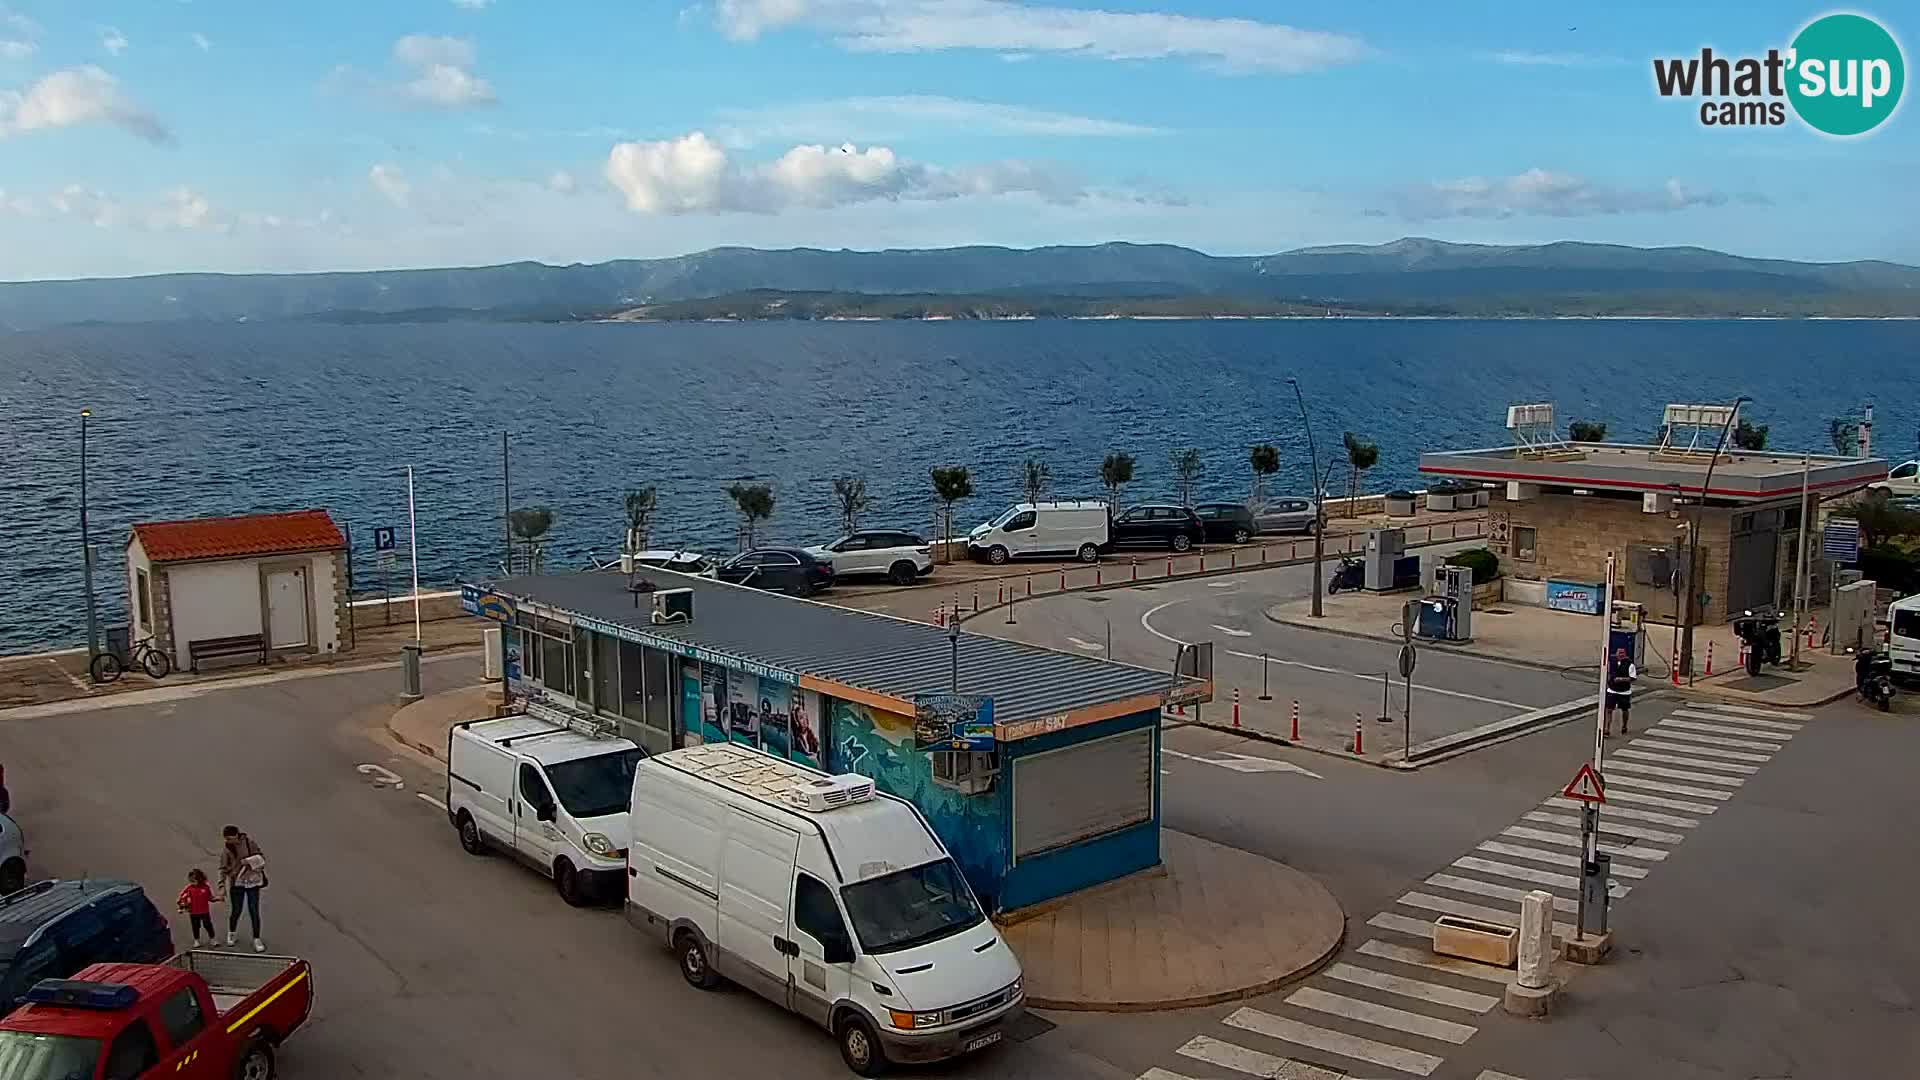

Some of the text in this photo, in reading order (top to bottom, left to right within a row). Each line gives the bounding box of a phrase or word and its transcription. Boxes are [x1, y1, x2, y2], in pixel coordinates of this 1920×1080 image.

[379, 530, 391, 548] P
[711, 653, 741, 669] STATION
[744, 662, 768, 677] TICKET
[769, 669, 795, 683] OFFICE
